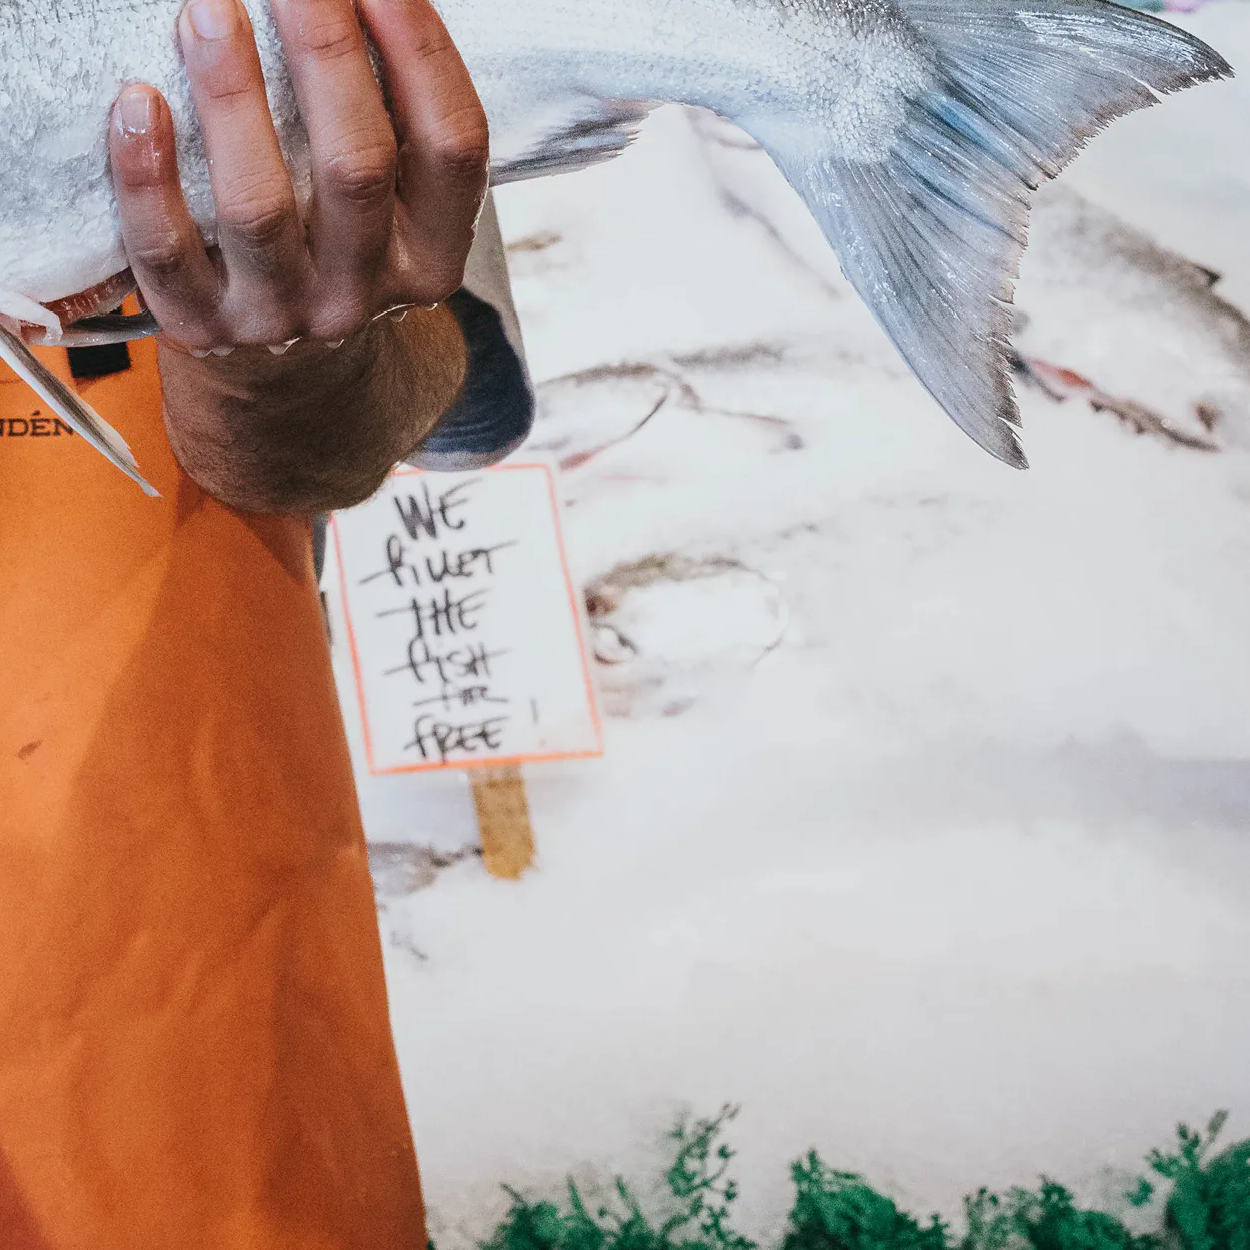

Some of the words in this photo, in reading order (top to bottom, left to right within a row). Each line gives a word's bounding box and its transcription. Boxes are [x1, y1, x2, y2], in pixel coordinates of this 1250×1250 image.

[393, 477, 483, 540] WE
[376, 588, 491, 637] THE
[382, 636, 512, 684] FISH
